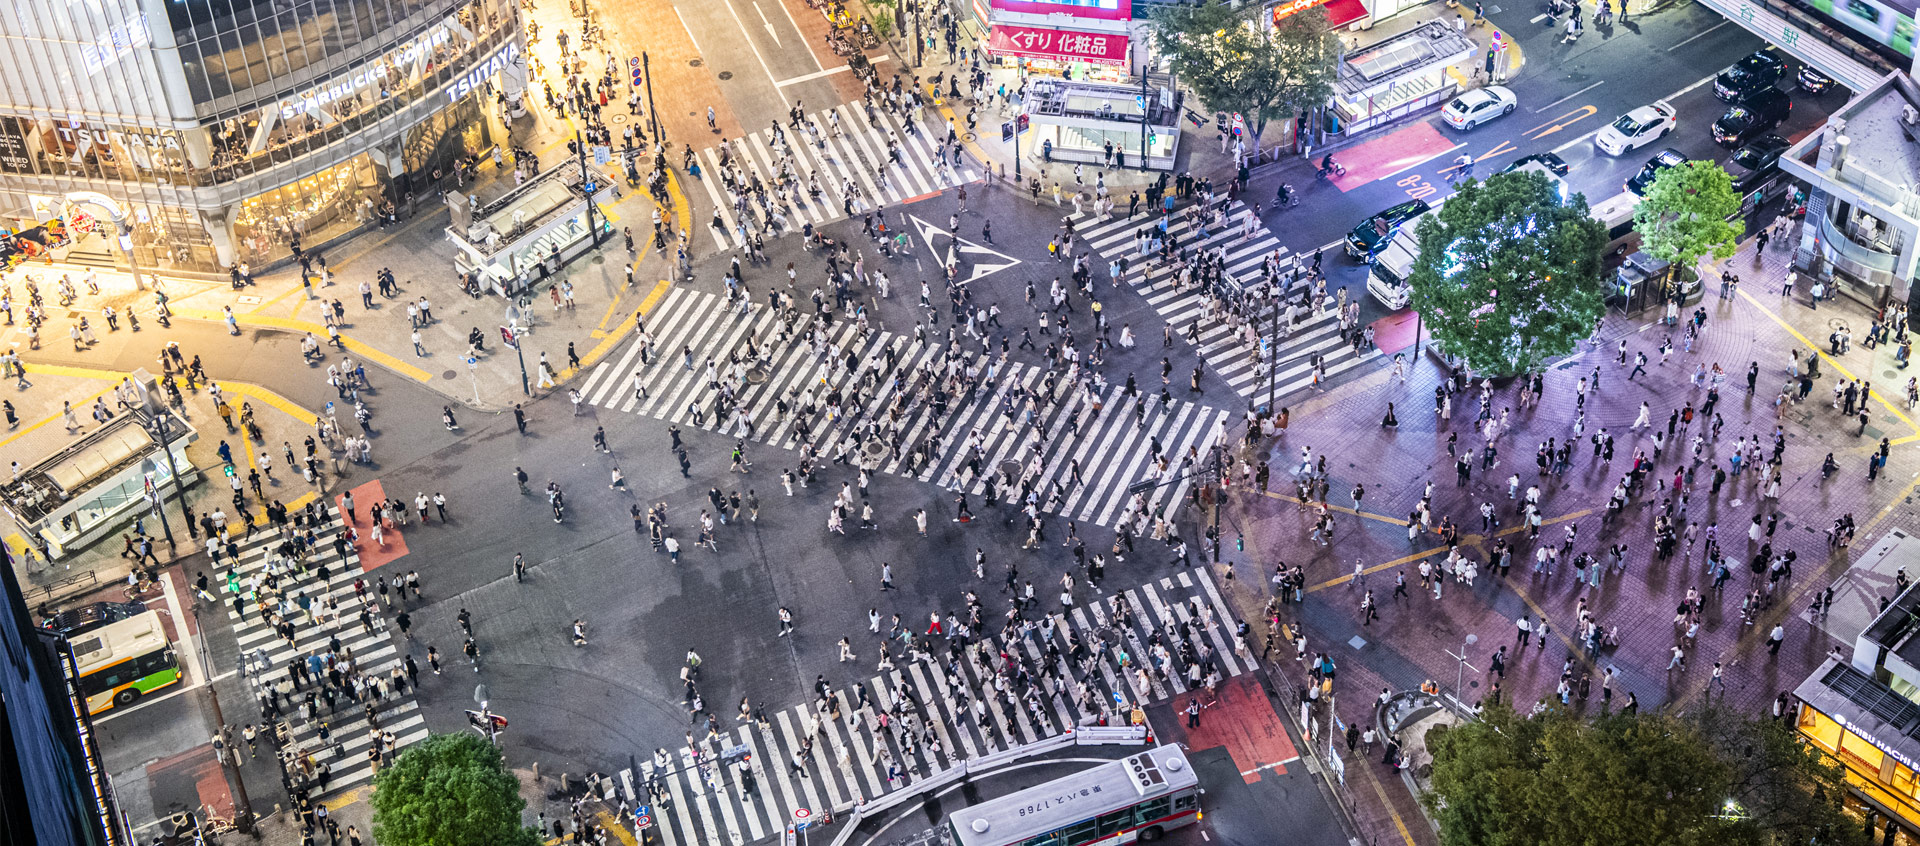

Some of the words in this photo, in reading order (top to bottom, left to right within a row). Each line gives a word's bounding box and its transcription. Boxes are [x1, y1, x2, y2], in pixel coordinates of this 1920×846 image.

[1010, 30, 1051, 50] くすり
[1057, 33, 1107, 56] 化粧品
[445, 42, 519, 102] TSUTAYA
[281, 64, 386, 120] STARBUCKS
[58, 127, 180, 150] TSUTAYA
[1396, 174, 1437, 199] 8-20
[1845, 721, 1876, 744] SHIBU
[1876, 740, 1912, 766] HACHI
[1911, 761, 1920, 772] B
[1055, 784, 1102, 804] 東急バス
